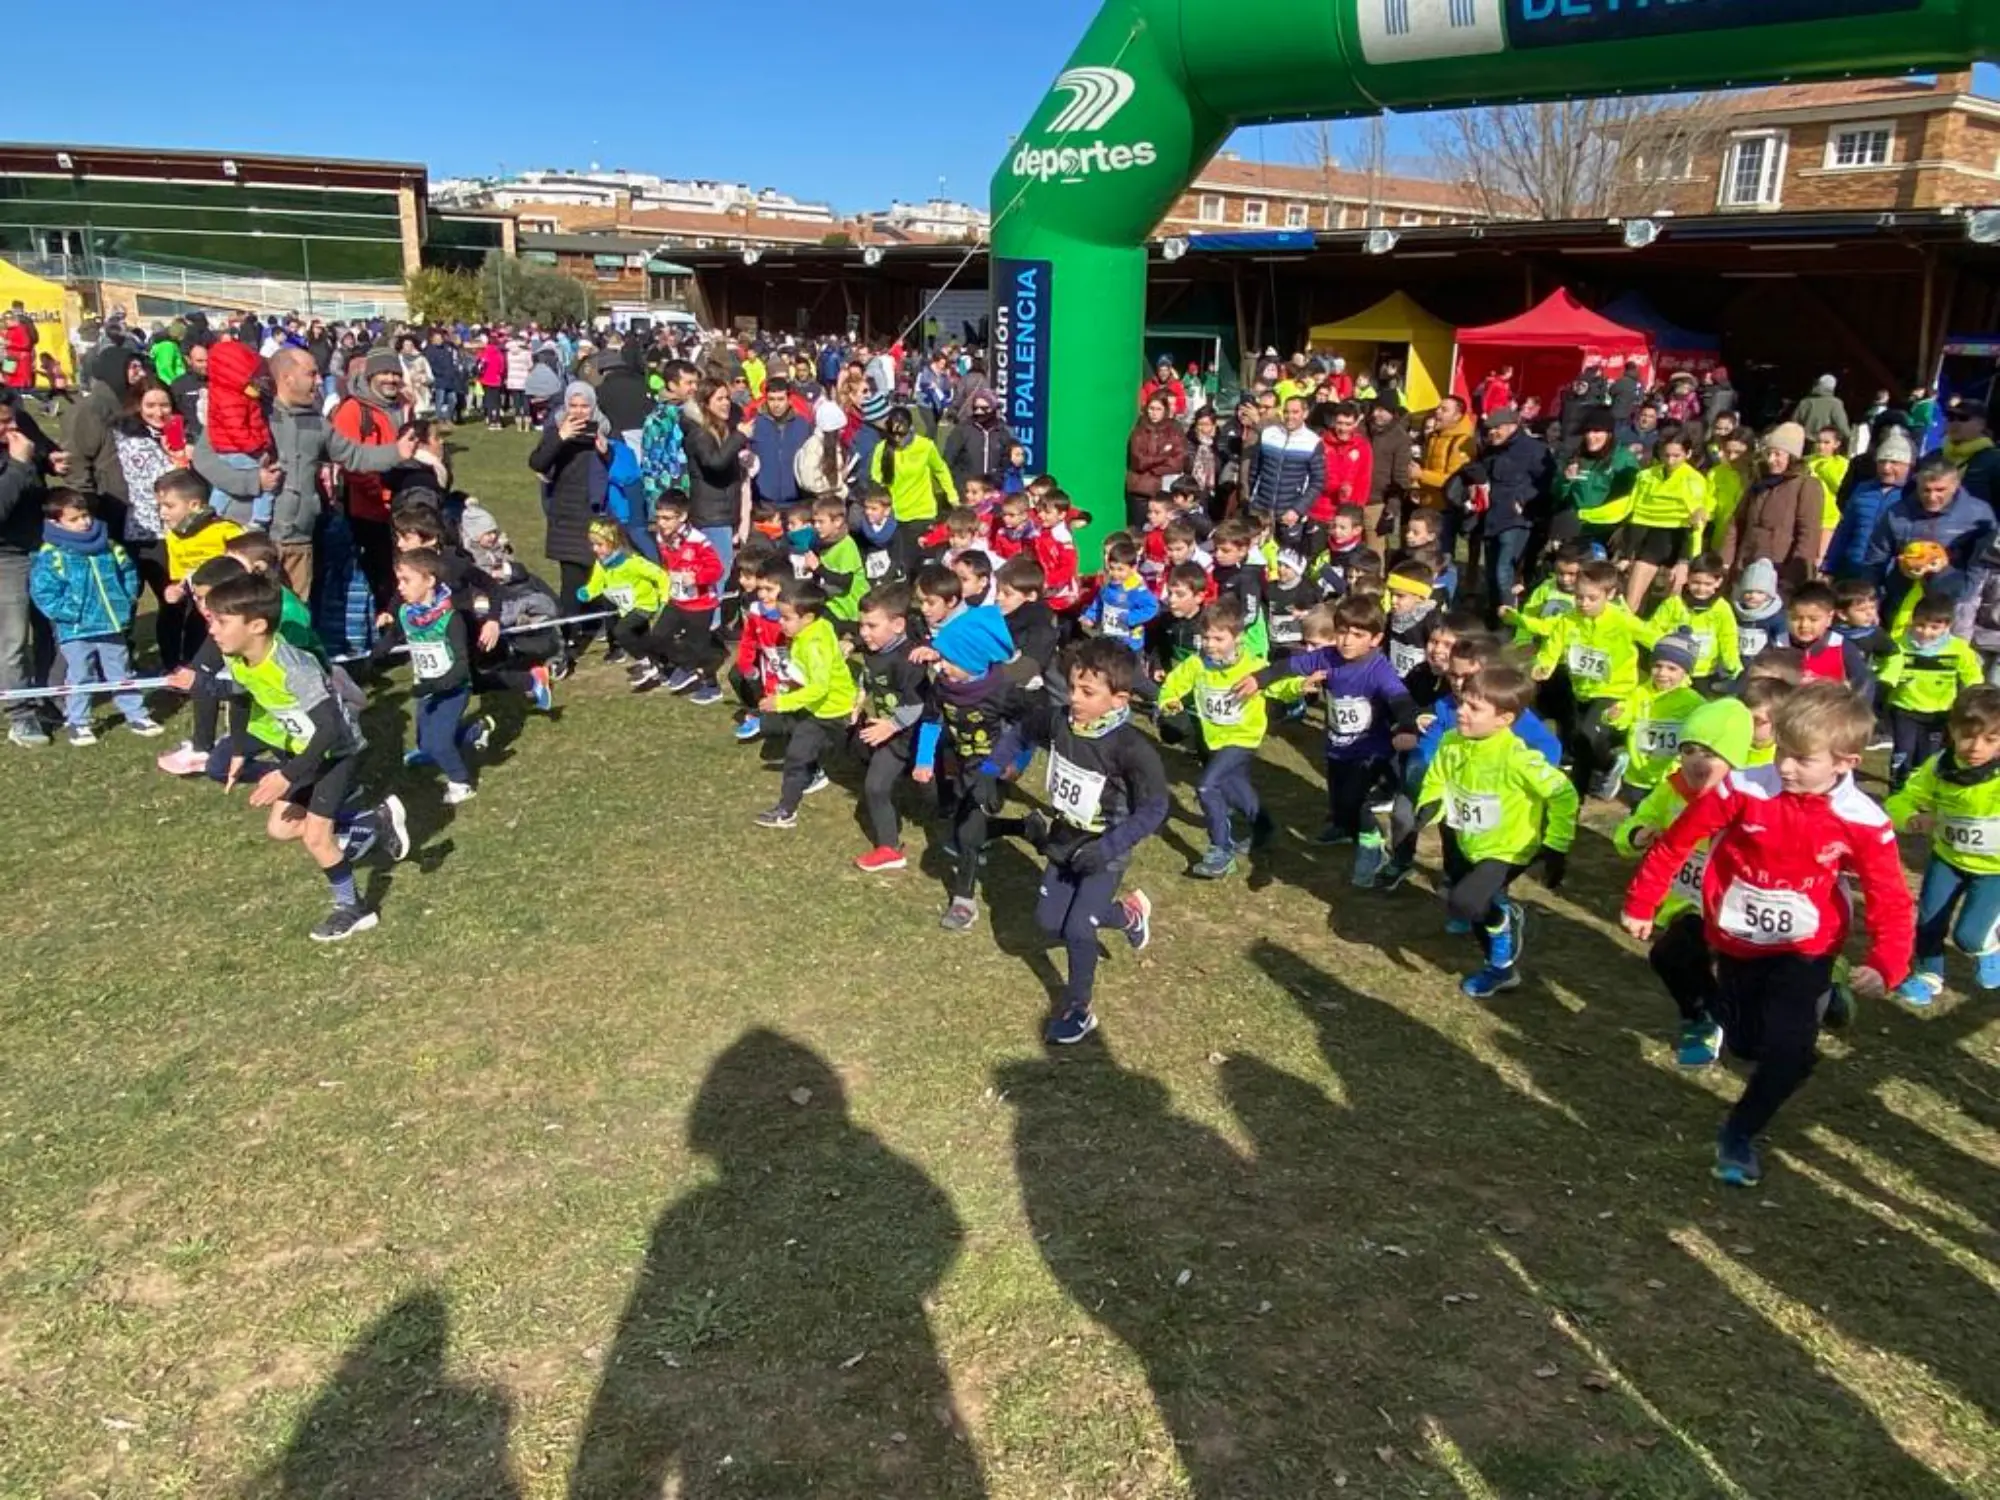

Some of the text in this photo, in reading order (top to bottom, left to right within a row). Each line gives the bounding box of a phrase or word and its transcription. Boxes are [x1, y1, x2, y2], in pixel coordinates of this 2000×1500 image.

[1012, 140, 1157, 183] deportes
[994, 306, 1009, 422] utación
[1014, 268, 1037, 417] PALENCIA
[1206, 697, 1232, 716] 642
[1745, 902, 1794, 933] 568
